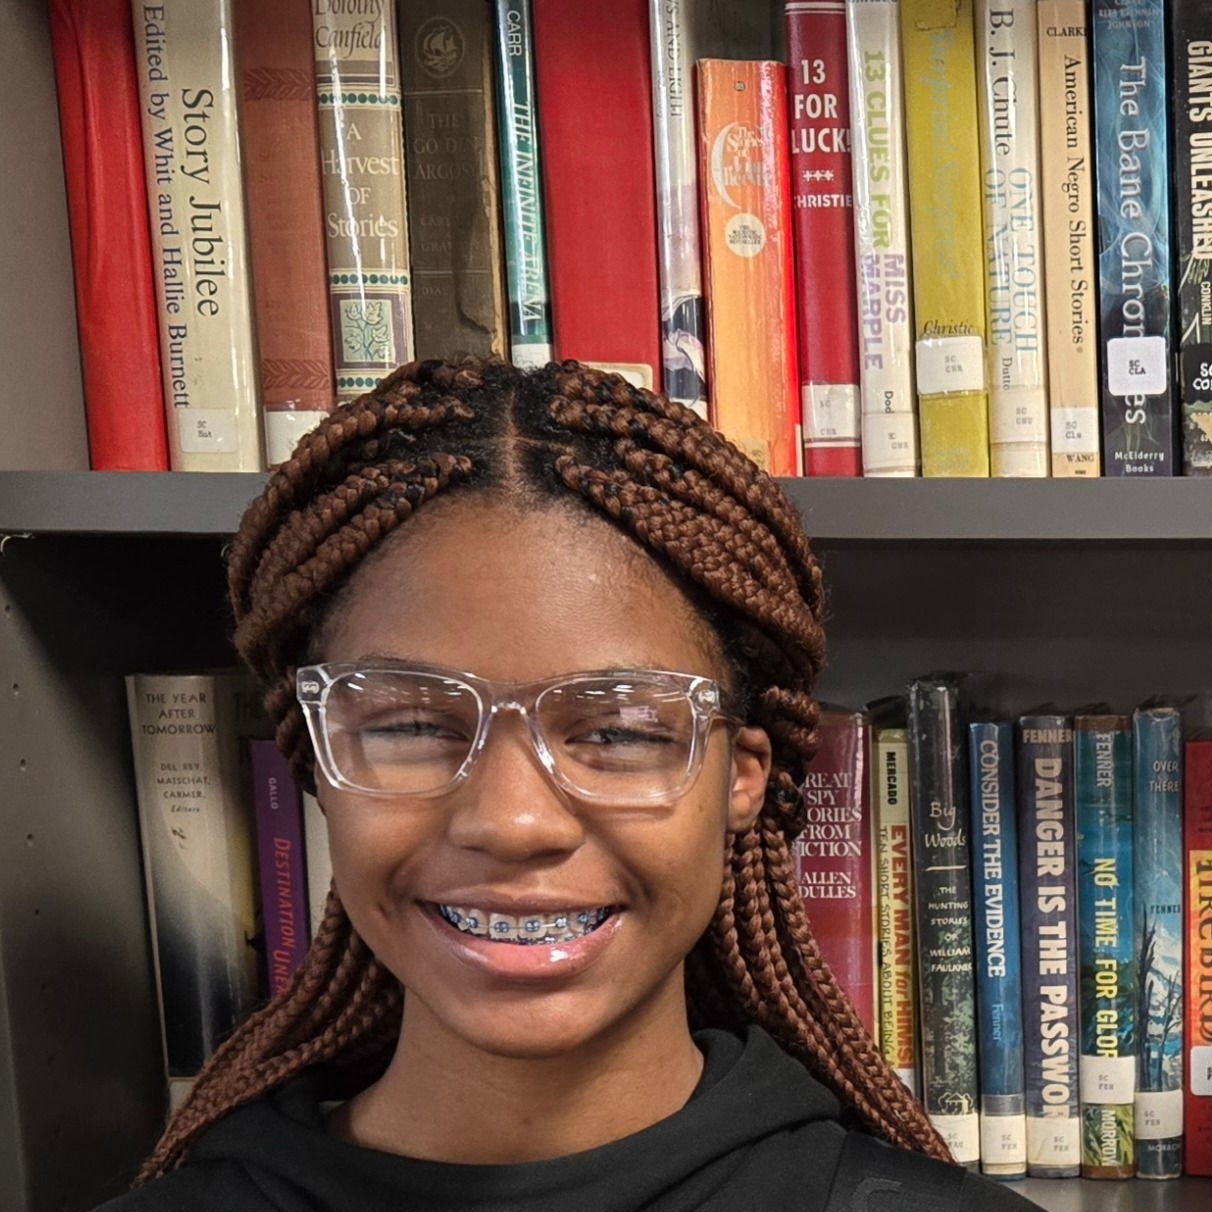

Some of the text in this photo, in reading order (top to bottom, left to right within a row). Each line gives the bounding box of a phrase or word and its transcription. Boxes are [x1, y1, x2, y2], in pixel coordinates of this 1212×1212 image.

[507, 10, 522, 57] CARR
[801, 60, 826, 84] 13
[990, 9, 1018, 156] B. J. Chute
[794, 94, 838, 118] FOR
[346, 123, 361, 140] A
[514, 102, 532, 145] THE
[791, 128, 852, 153] LUCK!
[864, 51, 892, 249] 13 CLUES FOR
[143, 5, 189, 408] Edited by Whit and Hallie Burnett
[180, 88, 226, 317] Story Jubilee
[1061, 55, 1088, 346] American Negro Short Stories
[327, 213, 398, 238] Stories
[1119, 57, 1152, 425] The Bane Chrones
[984, 168, 1013, 346] OF NATURE
[1008, 166, 1038, 353] ONE TOUCH
[520, 245, 543, 322] ARENA
[884, 254, 906, 323] MISS
[861, 253, 884, 370] MARPLE
[1201, 280, 1212, 325] CONKLIN
[1129, 360, 1140, 368] SC
[1129, 367, 1147, 375] CLA
[1114, 450, 1164, 462] McElderry
[1125, 463, 1155, 473] Books
[146, 692, 207, 704] THE YEAR
[158, 708, 195, 720] AFTER
[142, 723, 216, 736] TOMORROW
[1022, 730, 1074, 743] FENNER
[160, 762, 178, 772] DEL
[1095, 732, 1115, 788] FENNER
[1153, 759, 1180, 773] OVER
[804, 773, 853, 789] REAT
[886, 752, 898, 806] MERCADO
[1149, 780, 1181, 793] THERE
[268, 777, 279, 810] GALLO
[806, 789, 840, 807] SPY
[806, 806, 863, 823] ORIES
[930, 801, 958, 832] Big
[800, 824, 851, 840] FROM
[925, 831, 967, 849] Woods
[980, 738, 1006, 978] CONSIDER THE EVIDENCE
[801, 872, 852, 885] ALLEN
[940, 886, 957, 895] THE
[273, 838, 296, 948] DESTINATION
[799, 885, 857, 900] DULLES
[891, 825, 912, 999] EVERY MAN for
[928, 902, 969, 911] HUNTING
[930, 916, 969, 926] STORIES
[879, 827, 894, 1055] TEN SHORT STORIES ABOUT BEING
[944, 932, 958, 941] OF
[1034, 757, 1071, 1119] DANGER IS THE PASSWOR
[929, 947, 971, 957] WILLIAM
[1093, 857, 1118, 1059] NO TIME FOR GLOR
[991, 1003, 1004, 1042] Fenner
